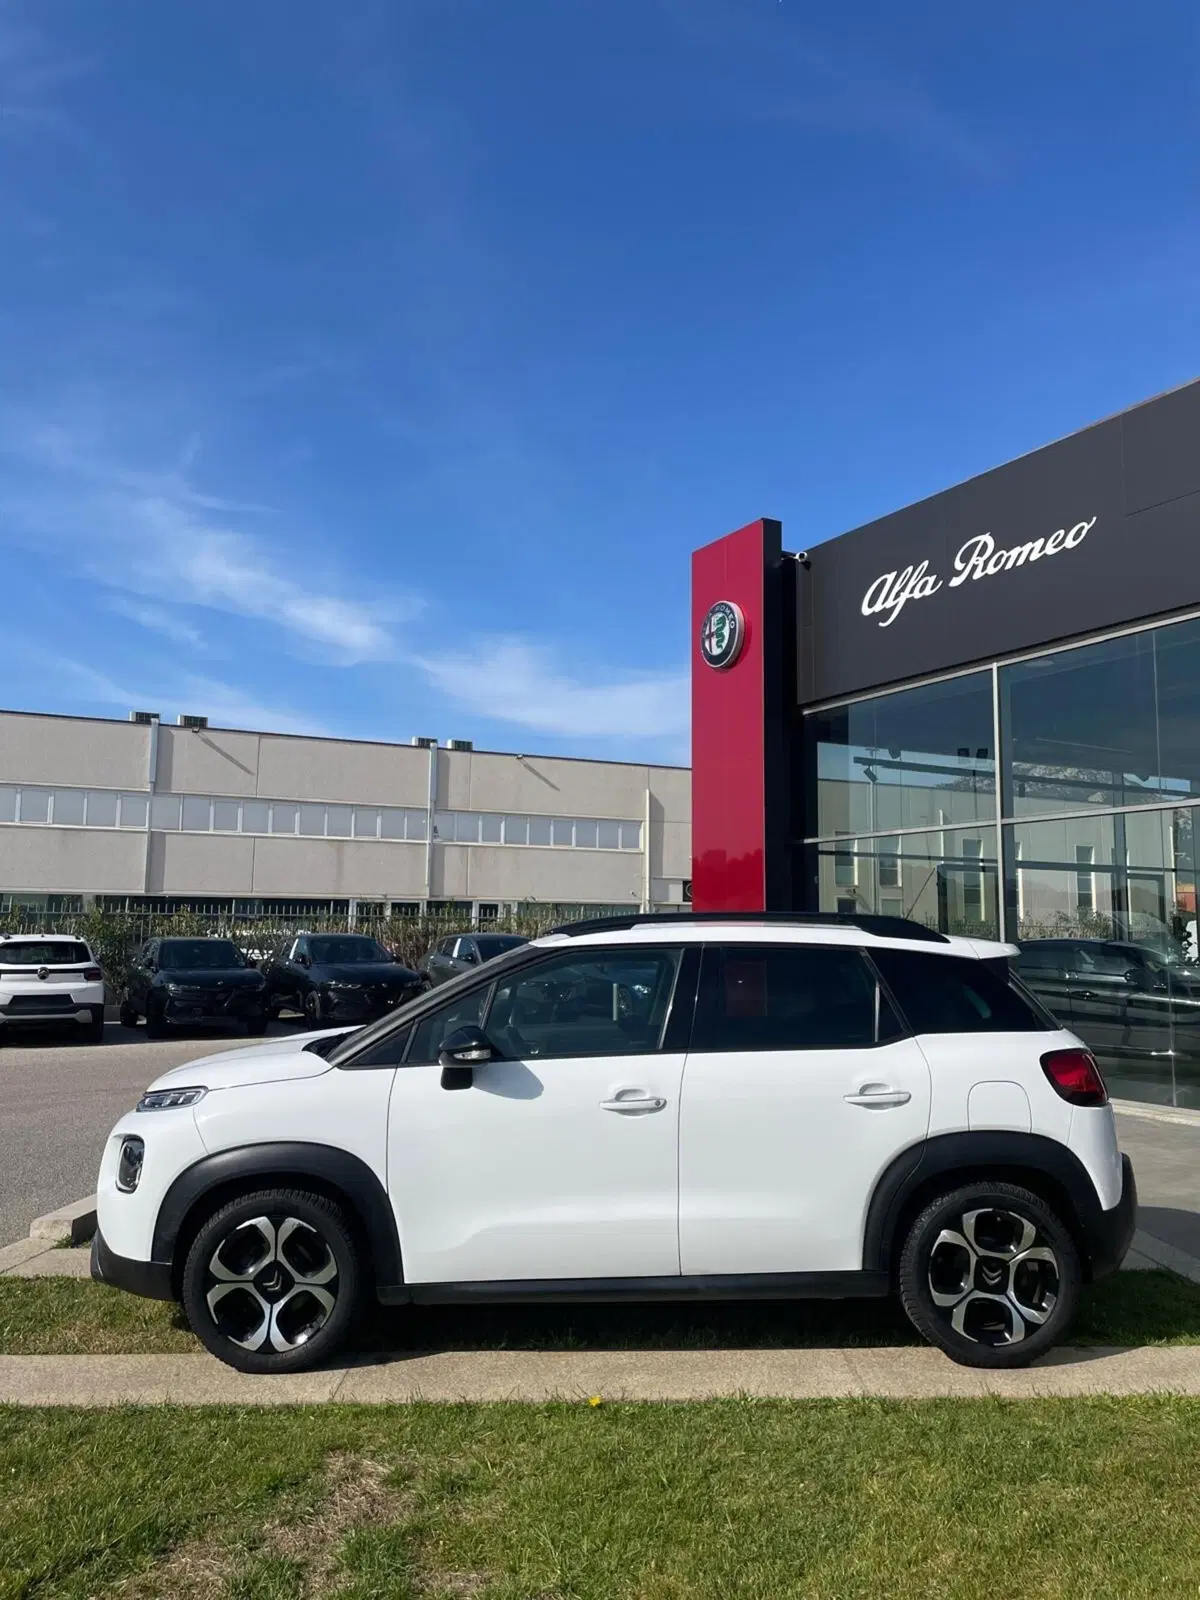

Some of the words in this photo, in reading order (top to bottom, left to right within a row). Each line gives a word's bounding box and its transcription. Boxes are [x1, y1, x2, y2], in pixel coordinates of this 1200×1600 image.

[861, 559, 944, 628] Alfa
[948, 516, 1097, 588] Romeo
[715, 604, 735, 629] ROMEO
